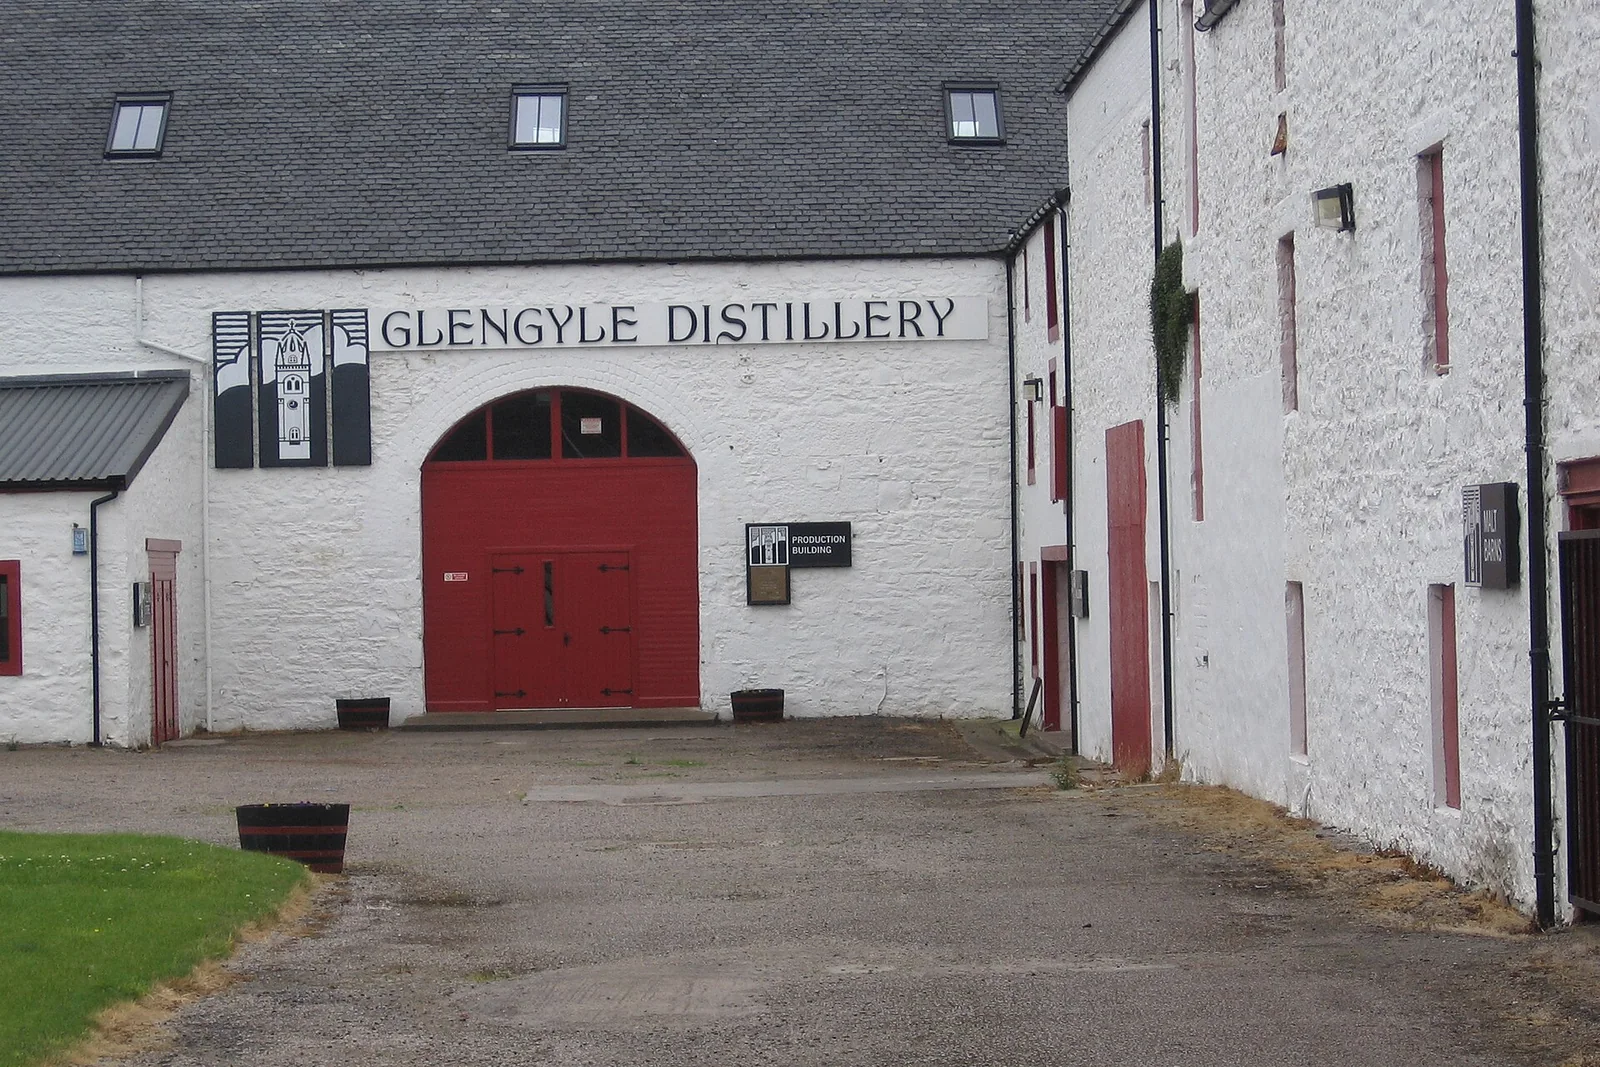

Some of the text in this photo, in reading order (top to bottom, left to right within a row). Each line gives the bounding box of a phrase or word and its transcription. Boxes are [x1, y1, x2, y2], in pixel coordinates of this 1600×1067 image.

[381, 298, 955, 348] GLENGYLE DISTILLERY
[1483, 509, 1498, 532] MALT
[791, 535, 846, 544] PRODUCTION
[792, 546, 832, 555] BUILDING
